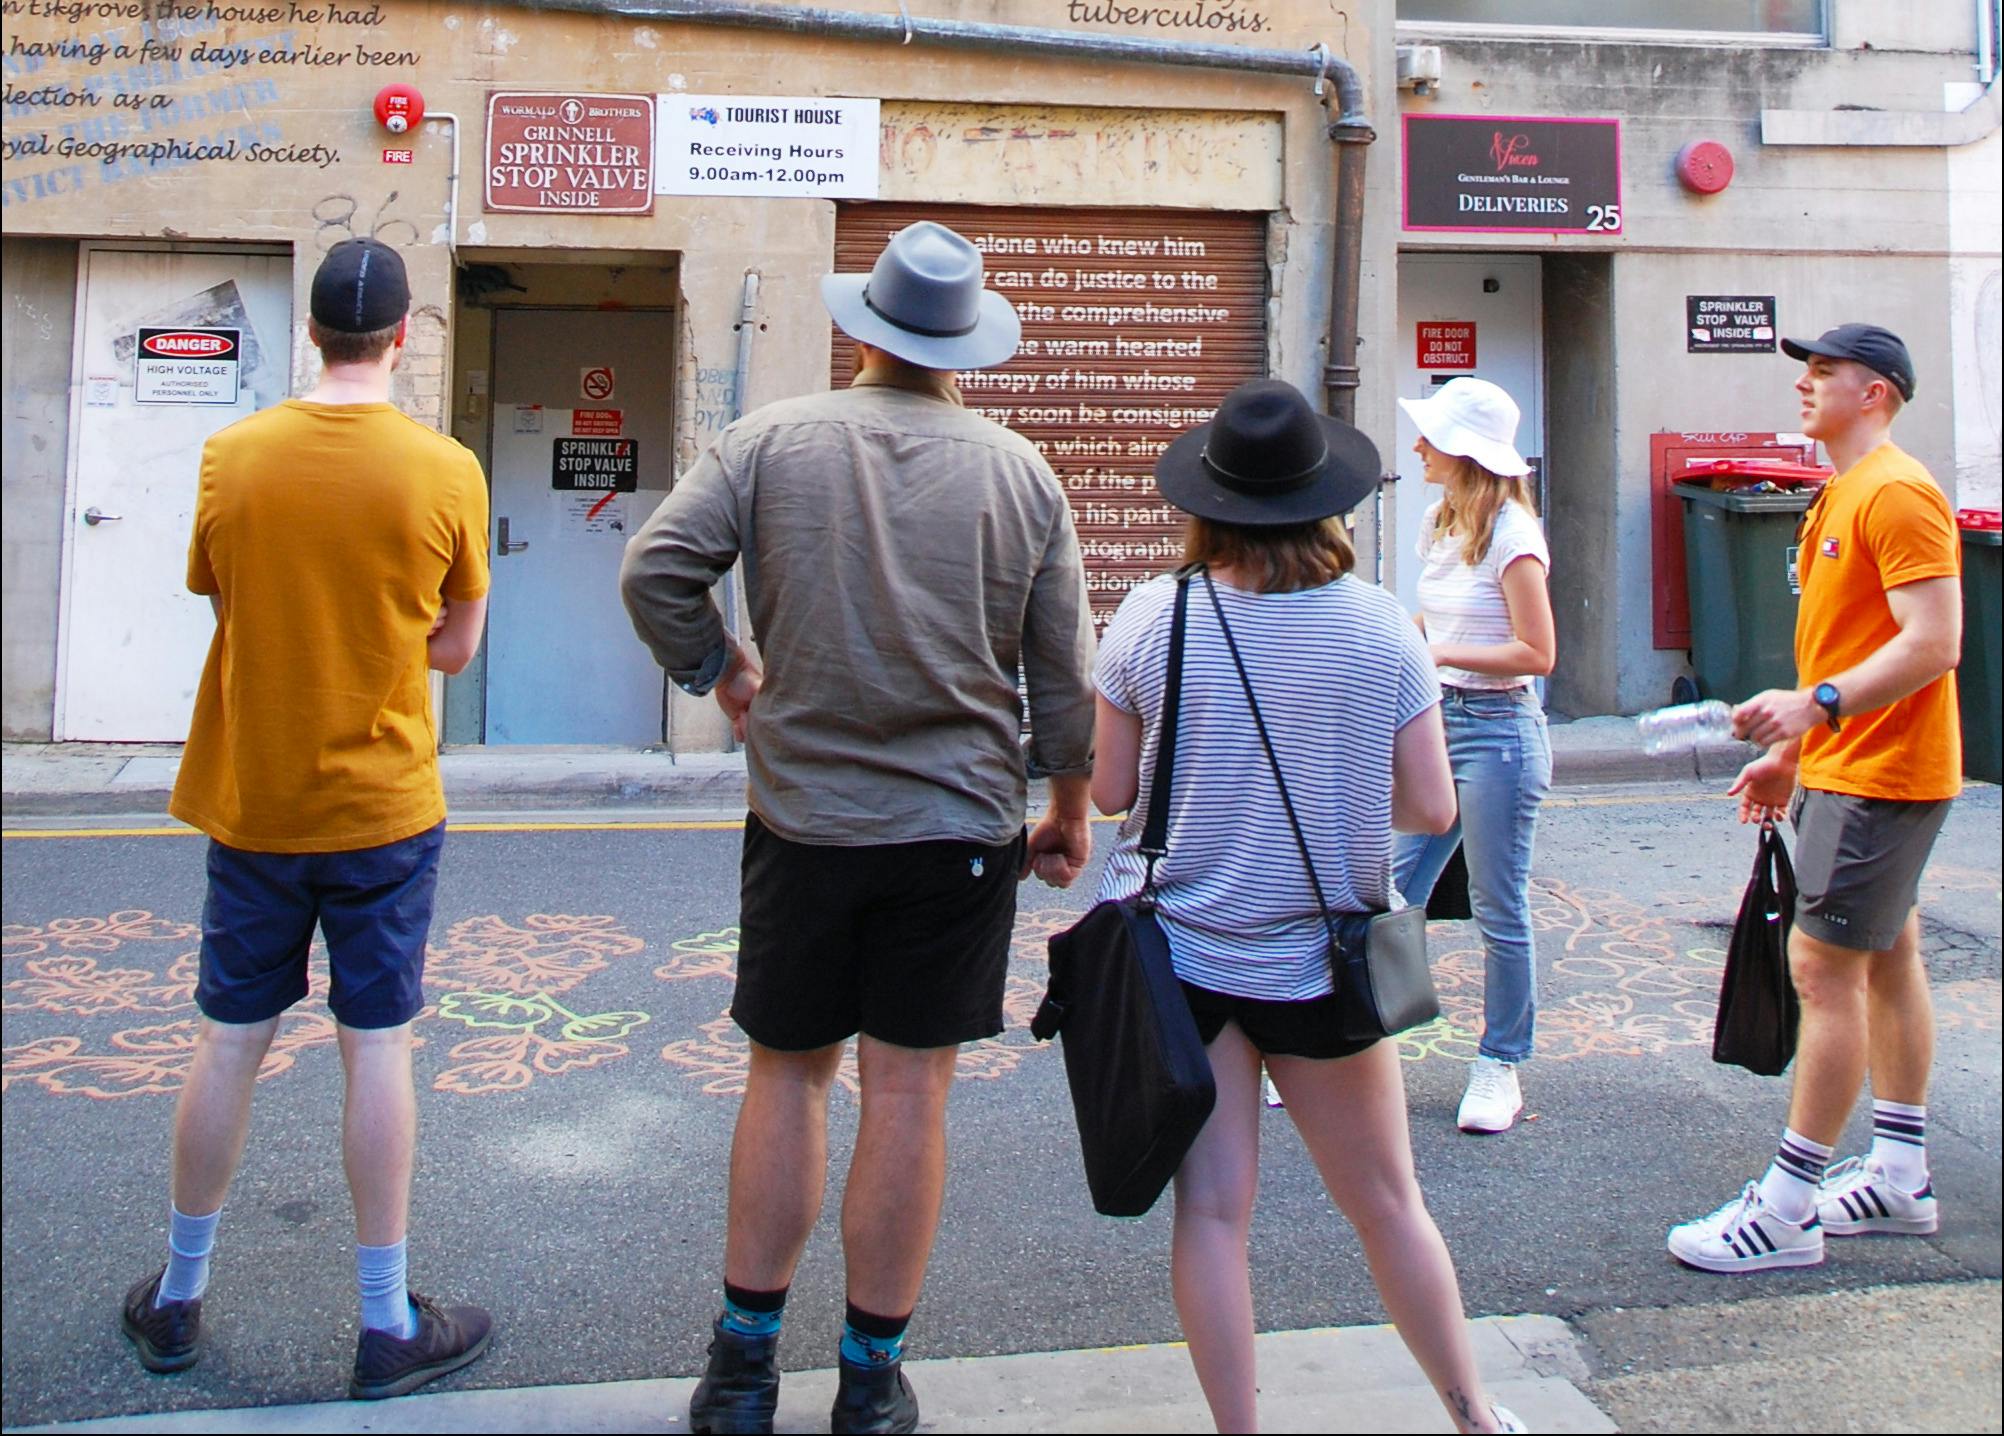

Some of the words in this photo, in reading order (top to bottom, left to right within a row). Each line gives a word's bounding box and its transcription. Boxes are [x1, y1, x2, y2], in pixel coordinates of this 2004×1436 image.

[157, 3, 205, 20] the
[206, 1, 286, 24] house
[288, 2, 325, 23] he
[327, 4, 387, 26] had
[1067, 0, 1272, 32] tuberculosis.
[10, 36, 110, 66] having
[115, 44, 137, 59] a
[140, 39, 182, 64] few
[190, 42, 256, 68] days
[258, 45, 351, 66] earlier
[355, 45, 421, 66] been
[2, 84, 102, 108] lection
[113, 92, 147, 110] as
[150, 92, 174, 108] a
[502, 105, 556, 117] WORMALD
[588, 106, 642, 118] BROTHERS
[726, 107, 788, 124] TOURIST
[795, 109, 843, 125] HOUSE
[523, 126, 616, 142] GRINNELL
[57, 137, 242, 166] Geographical
[245, 142, 341, 169] Society.
[385, 150, 411, 162] FIRE
[500, 143, 640, 167] SPRINKLER
[690, 142, 782, 161] Receiving
[789, 145, 844, 159] Hours
[491, 166, 558, 188] STOP
[565, 168, 648, 190] VALVE
[689, 167, 845, 186] 9.00am-12.00pm
[539, 191, 600, 206] INSIDE
[1459, 194, 1569, 214] DELIVERIES
[1586, 205, 1621, 231] 25
[975, 233, 1037, 254] alone
[1042, 235, 1091, 255] who
[1097, 235, 1158, 256] knew
[1163, 236, 1205, 256] him
[995, 271, 1034, 288] can
[1040, 268, 1067, 290] do
[1073, 269, 1146, 292] justice
[1152, 271, 1175, 290] to
[1181, 271, 1217, 290] the
[1017, 302, 1055, 321] the
[1061, 304, 1230, 326] comprehensive
[1699, 301, 1763, 312] SPRINKLER
[1696, 314, 1727, 325] STOP
[1733, 315, 1768, 325] VALVE
[1423, 328, 1442, 338] FIRE
[1445, 328, 1469, 338] DOOR
[1713, 327, 1751, 338] INSIDE
[156, 338, 222, 351] DANGER
[1045, 340, 1108, 356] warm
[1115, 336, 1202, 357] hearted
[1430, 341, 1442, 352] DO
[1445, 341, 1462, 352] NOT
[1423, 353, 1469, 364] OBSTRUCT
[147, 365, 174, 374] HIGH
[177, 366, 227, 375] VOLTAGE
[955, 370, 1040, 393] nthropy
[1045, 367, 1070, 390] of
[1074, 370, 1116, 391] him
[1122, 371, 1196, 391] whose
[1017, 407, 1072, 424] soon
[1078, 403, 1107, 424] be
[1055, 436, 1122, 455] which
[1127, 436, 1169, 456] alre
[559, 457, 591, 471] STOP
[594, 458, 632, 472] VALVE
[574, 473, 616, 487] INSIDE
[1067, 469, 1094, 490] of
[1099, 469, 1136, 490] the
[1086, 502, 1120, 524] his
